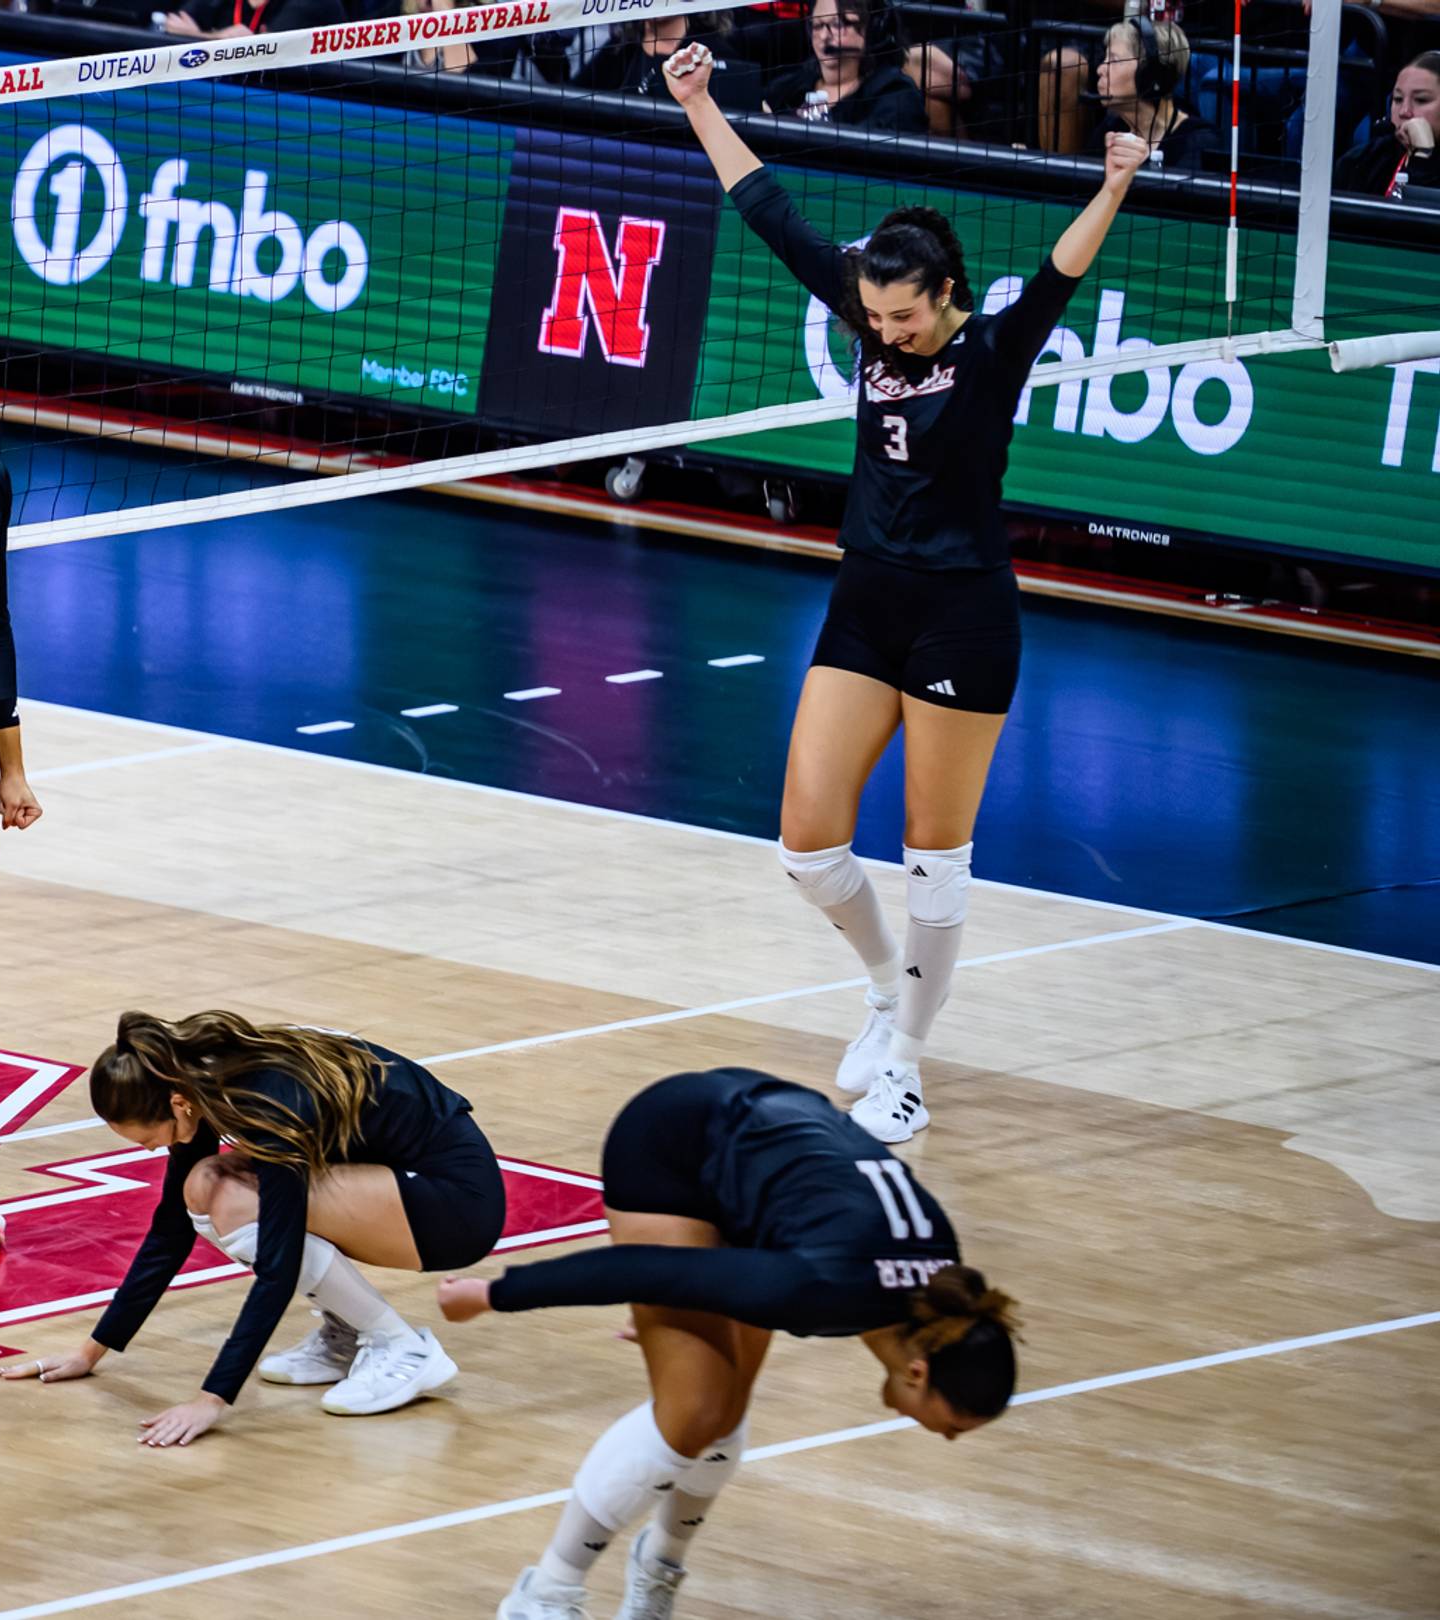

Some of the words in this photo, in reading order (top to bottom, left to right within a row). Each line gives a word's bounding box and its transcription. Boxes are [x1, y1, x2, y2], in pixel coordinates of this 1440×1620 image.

[310, 22, 402, 55] HUSKER
[407, 1, 552, 41] VOLLEYBALL
[78, 54, 156, 82] DUTEAU
[213, 42, 278, 62] SUBARU
[139, 158, 369, 312] fnbo
[538, 206, 666, 368] N
[882, 415, 909, 461] 3
[1088, 522, 1171, 546] DAKTRONICS
[855, 1160, 934, 1239] 11
